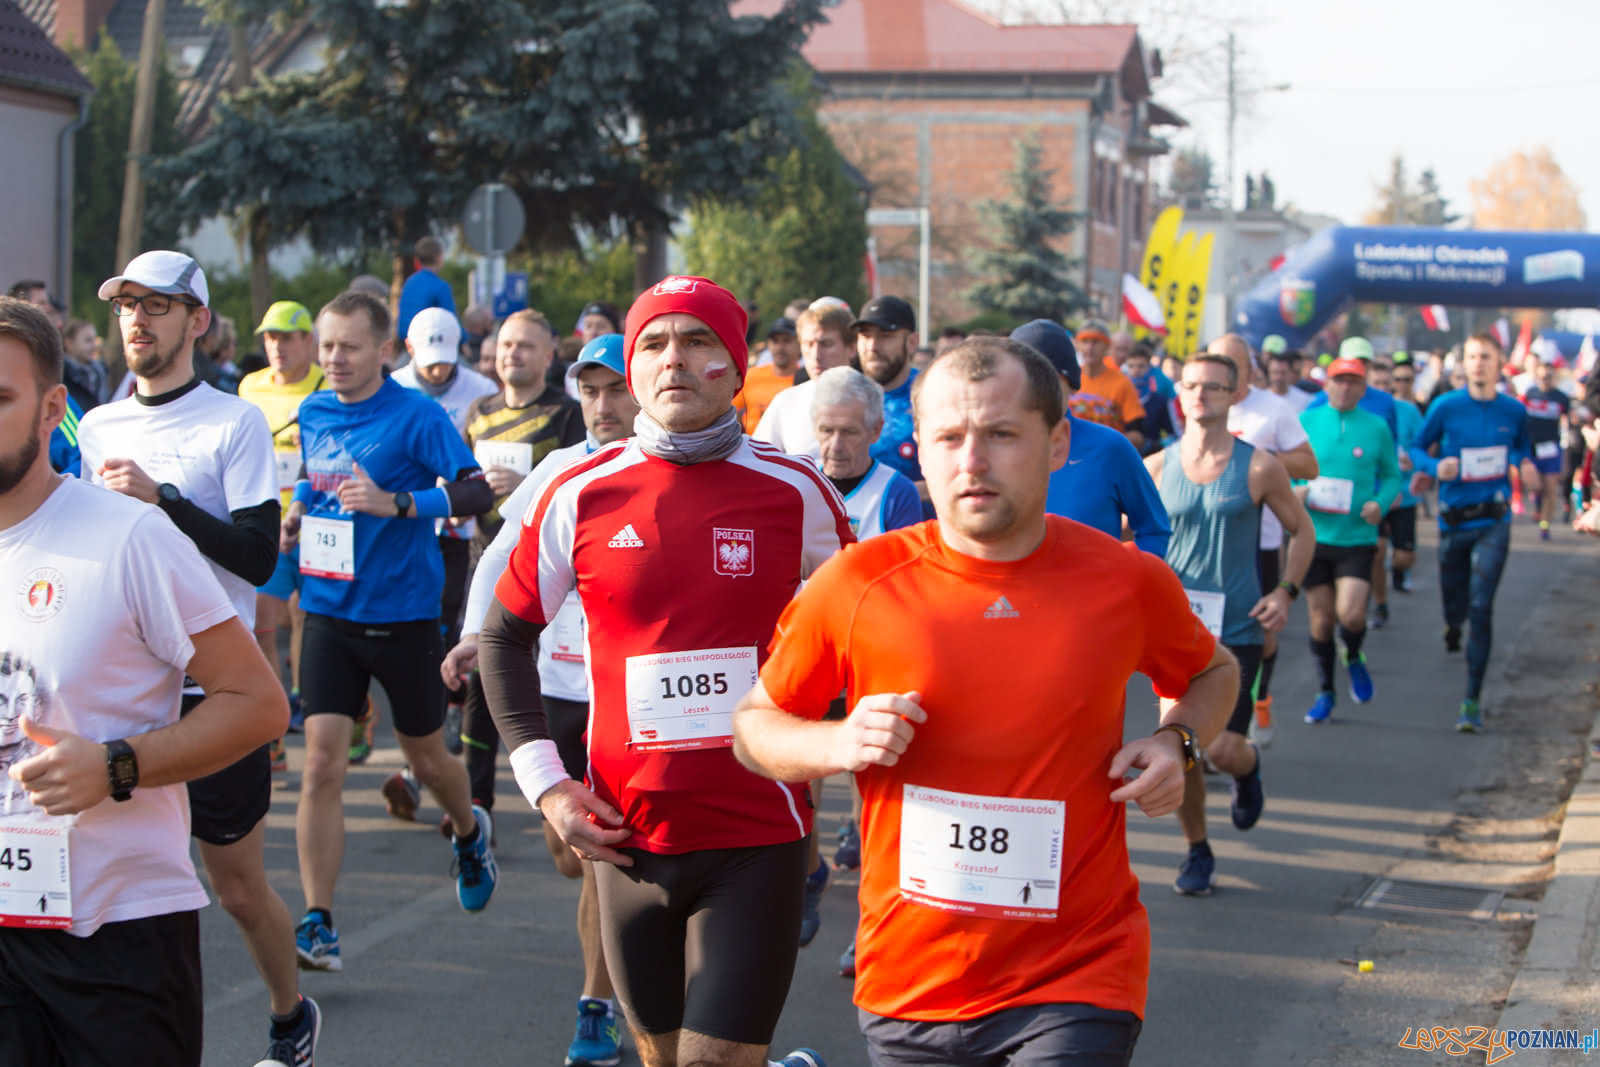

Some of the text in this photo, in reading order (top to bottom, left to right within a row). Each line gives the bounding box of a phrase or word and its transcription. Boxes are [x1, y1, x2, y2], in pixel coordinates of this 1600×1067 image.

[316, 532, 337, 548] 743
[716, 530, 751, 541] POLSKA
[608, 539, 644, 548] adidas
[675, 656, 692, 664] BIEG
[693, 651, 752, 662] NIEPODLEGŁOŚCI
[660, 672, 729, 699] 1085
[683, 705, 711, 714] Leszek
[917, 792, 959, 806] LUBOŃSKI
[960, 800, 981, 810] BIEG
[982, 803, 1057, 815] NIEPODLEGŁOŚCI
[949, 823, 1009, 855] 188
[0, 847, 33, 872] 45
[954, 861, 999, 875] Krzysztof
